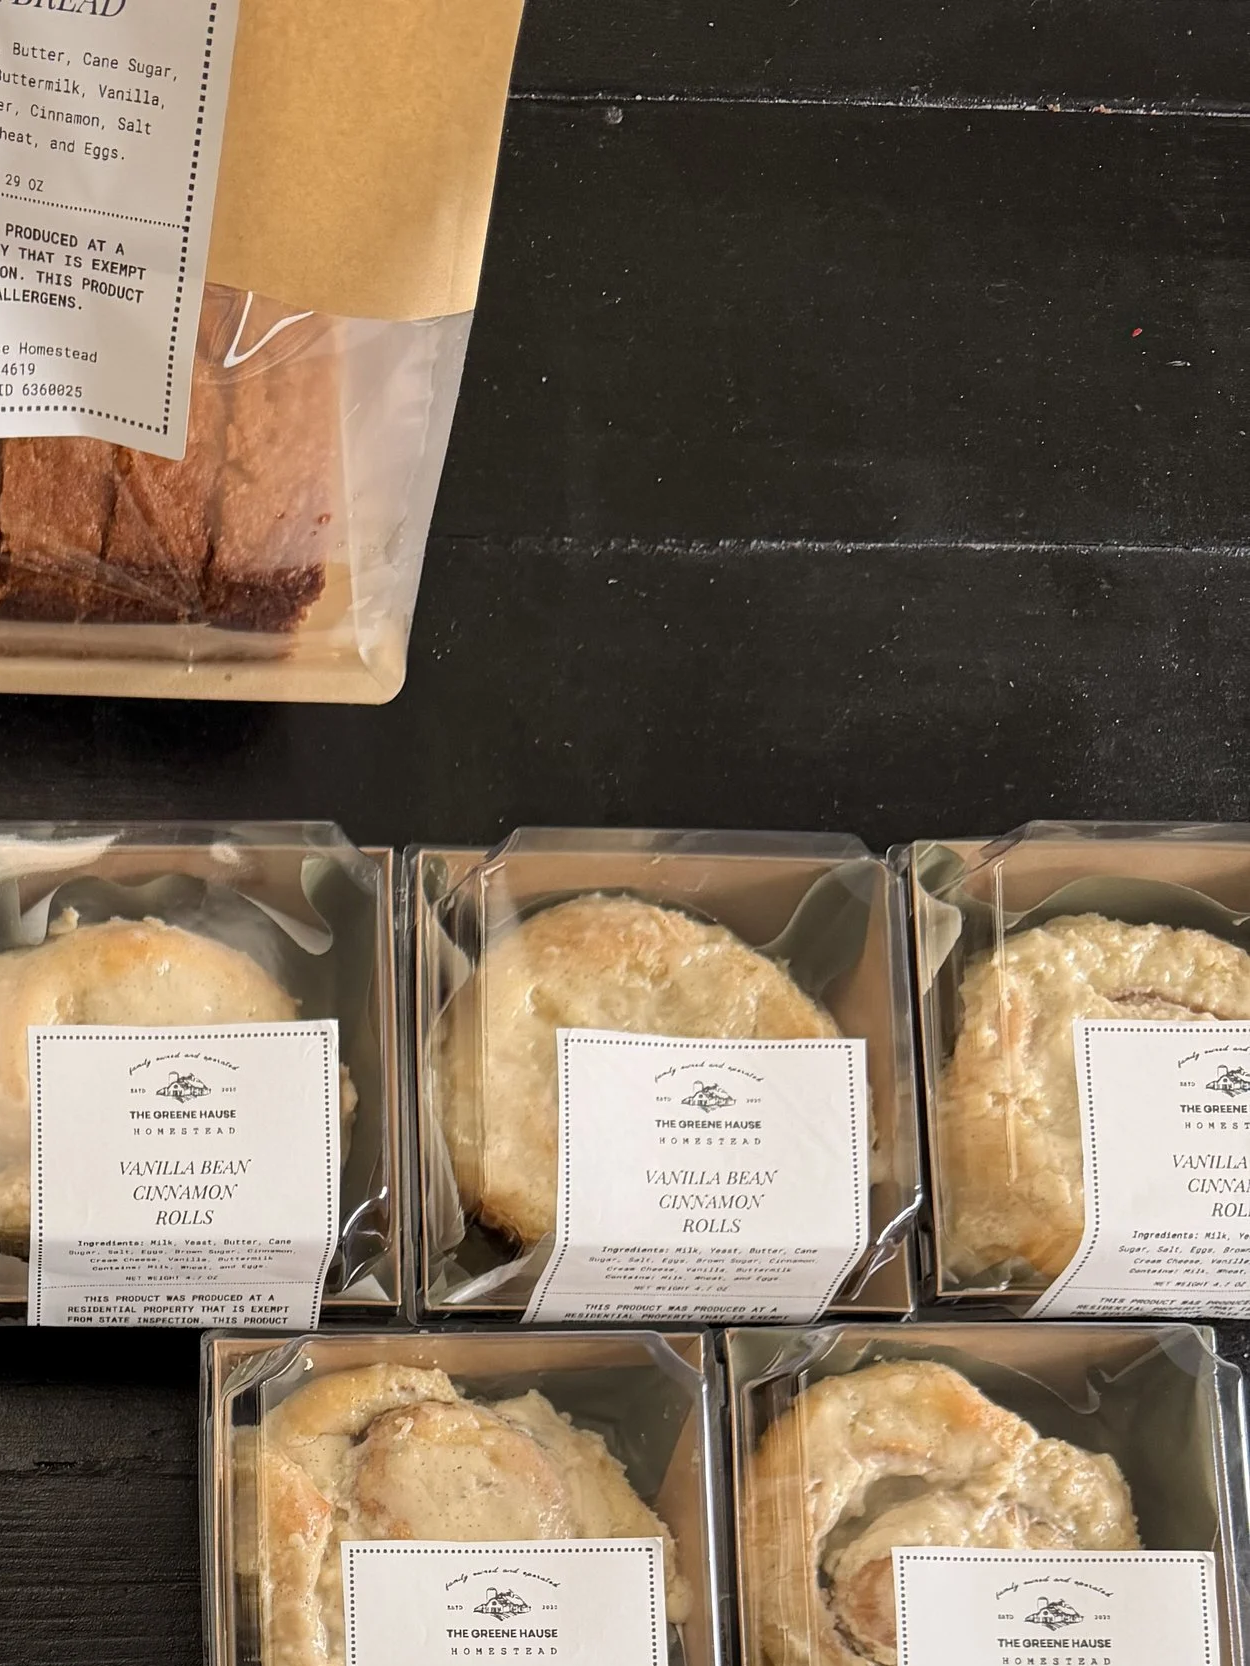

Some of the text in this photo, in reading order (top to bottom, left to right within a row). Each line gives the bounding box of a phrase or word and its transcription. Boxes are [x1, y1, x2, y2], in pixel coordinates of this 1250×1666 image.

[13, 42, 70, 66] Butter,
[83, 52, 118, 69] Cane
[128, 58, 176, 82] Sugar,
[99, 84, 164, 110] Vanilla,
[30, 104, 104, 130] Cinnamon,
[118, 117, 151, 135] Salt
[50, 139, 75, 153] and
[84, 142, 124, 161] Eggs.
[5, 174, 20, 187] 29
[28, 178, 43, 192] OZ
[6, 223, 78, 248] PRODUCED
[87, 238, 106, 252] AT
[115, 243, 124, 256] A
[19, 342, 97, 363] Homestead
[22, 383, 82, 398] 6360025
[129, 1109, 236, 1119] THE GREENE HAUSE
[1180, 1104, 1248, 1113] THE GREENE
[655, 1119, 762, 1129] THE GREENE HAUSE
[120, 1159, 251, 1177] VANILLA BEAN
[1173, 1154, 1247, 1170] VANILLA
[647, 1170, 778, 1186] VANILLA BEAN
[133, 1184, 238, 1202] CINNAMON
[659, 1194, 765, 1210] CINNAMON
[155, 1210, 214, 1226] ROLLS
[682, 1218, 741, 1233] ROLLS
[85, 1295, 109, 1303] THIS
[116, 1295, 161, 1303] PRODUCT
[446, 1629, 558, 1638] THE GREENE HAUSE
[997, 1638, 1111, 1648] THE GREENE HAUSE
